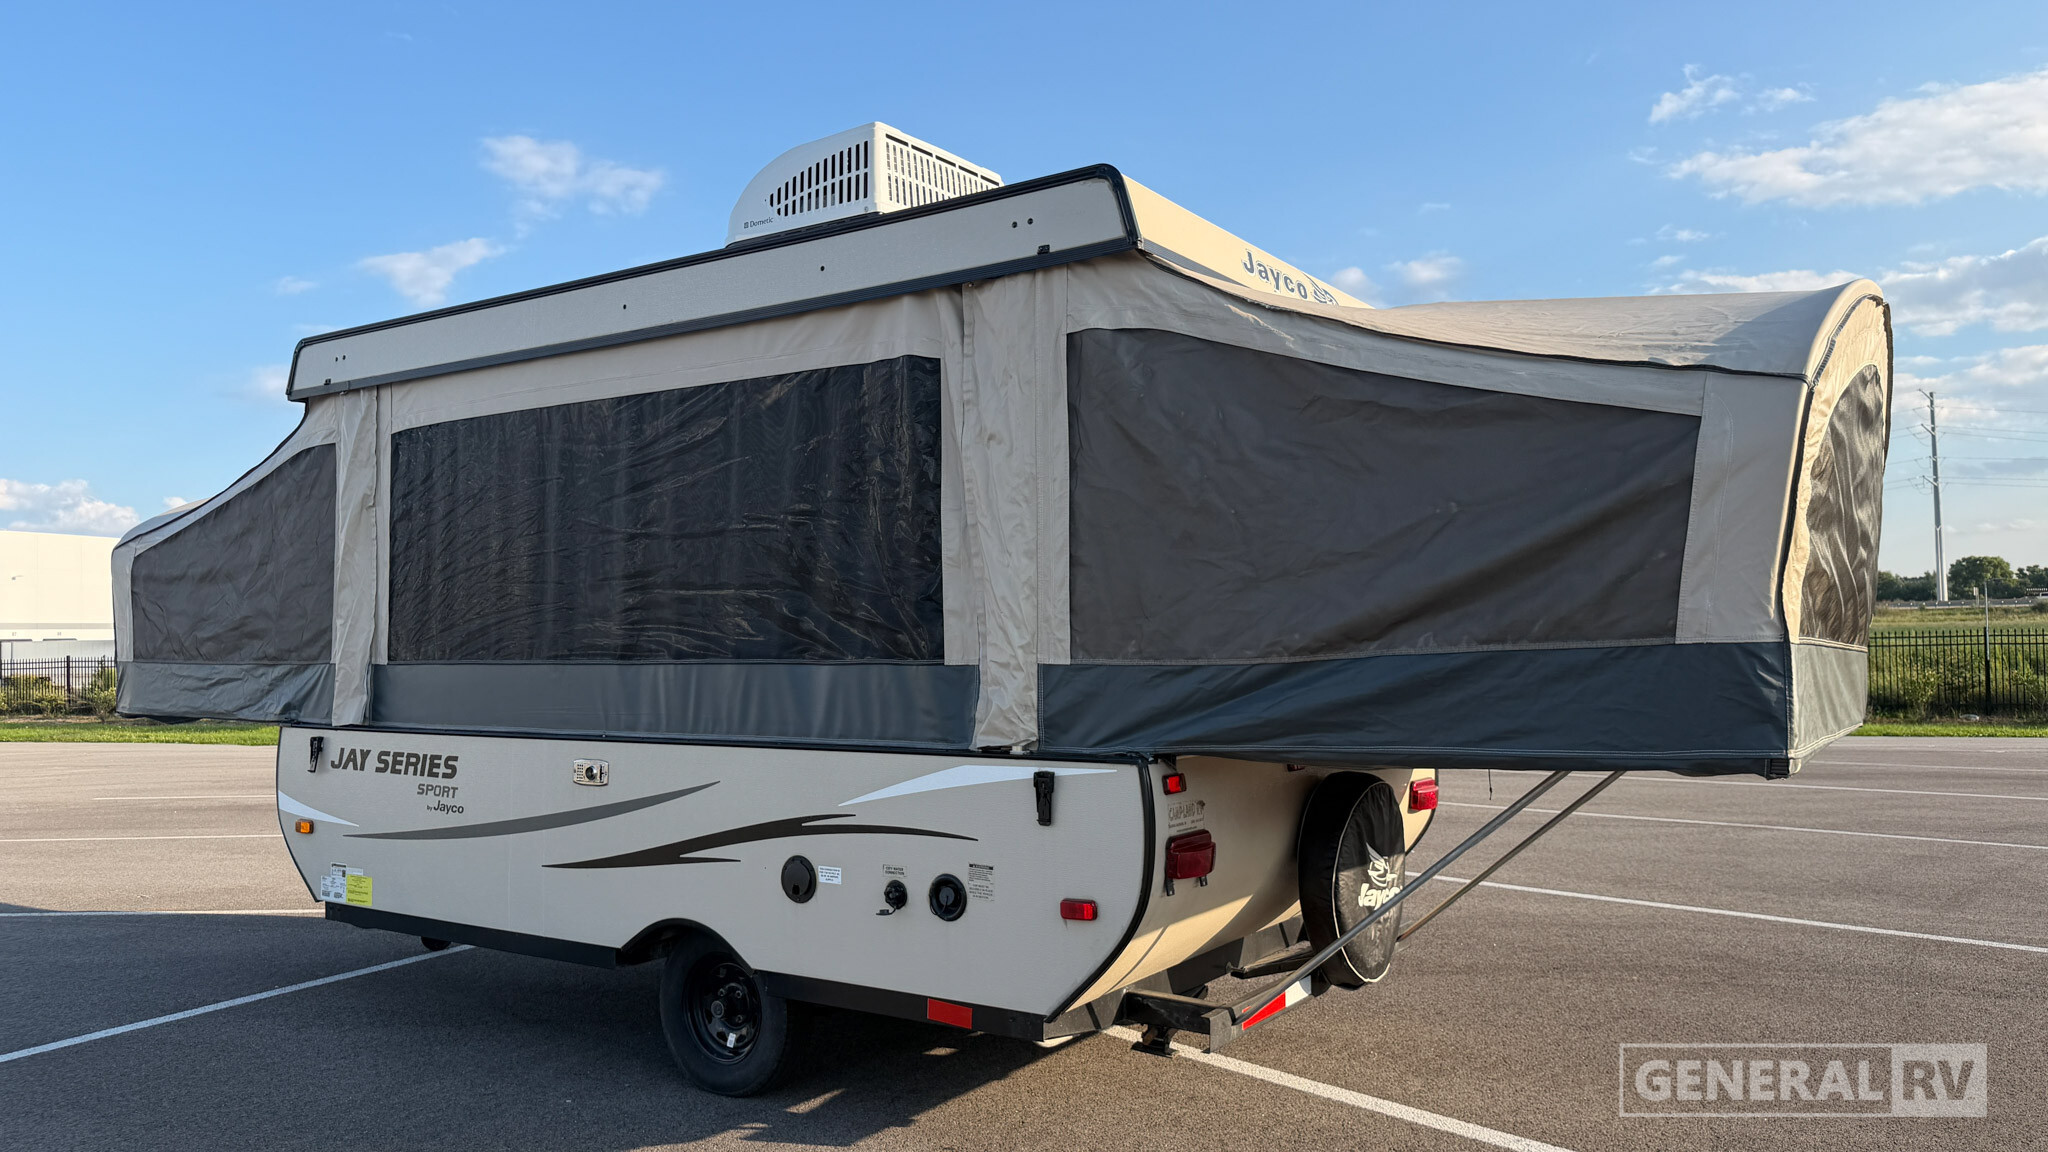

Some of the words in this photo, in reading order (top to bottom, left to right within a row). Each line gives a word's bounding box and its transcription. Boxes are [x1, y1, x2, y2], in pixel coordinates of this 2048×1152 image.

[750, 216, 774, 228] Dometic
[1241, 249, 1309, 300] Jayco
[330, 747, 372, 771] JAY
[375, 750, 459, 779] SERIES
[417, 783, 458, 798] SPORT
[433, 800, 465, 815] Jayco
